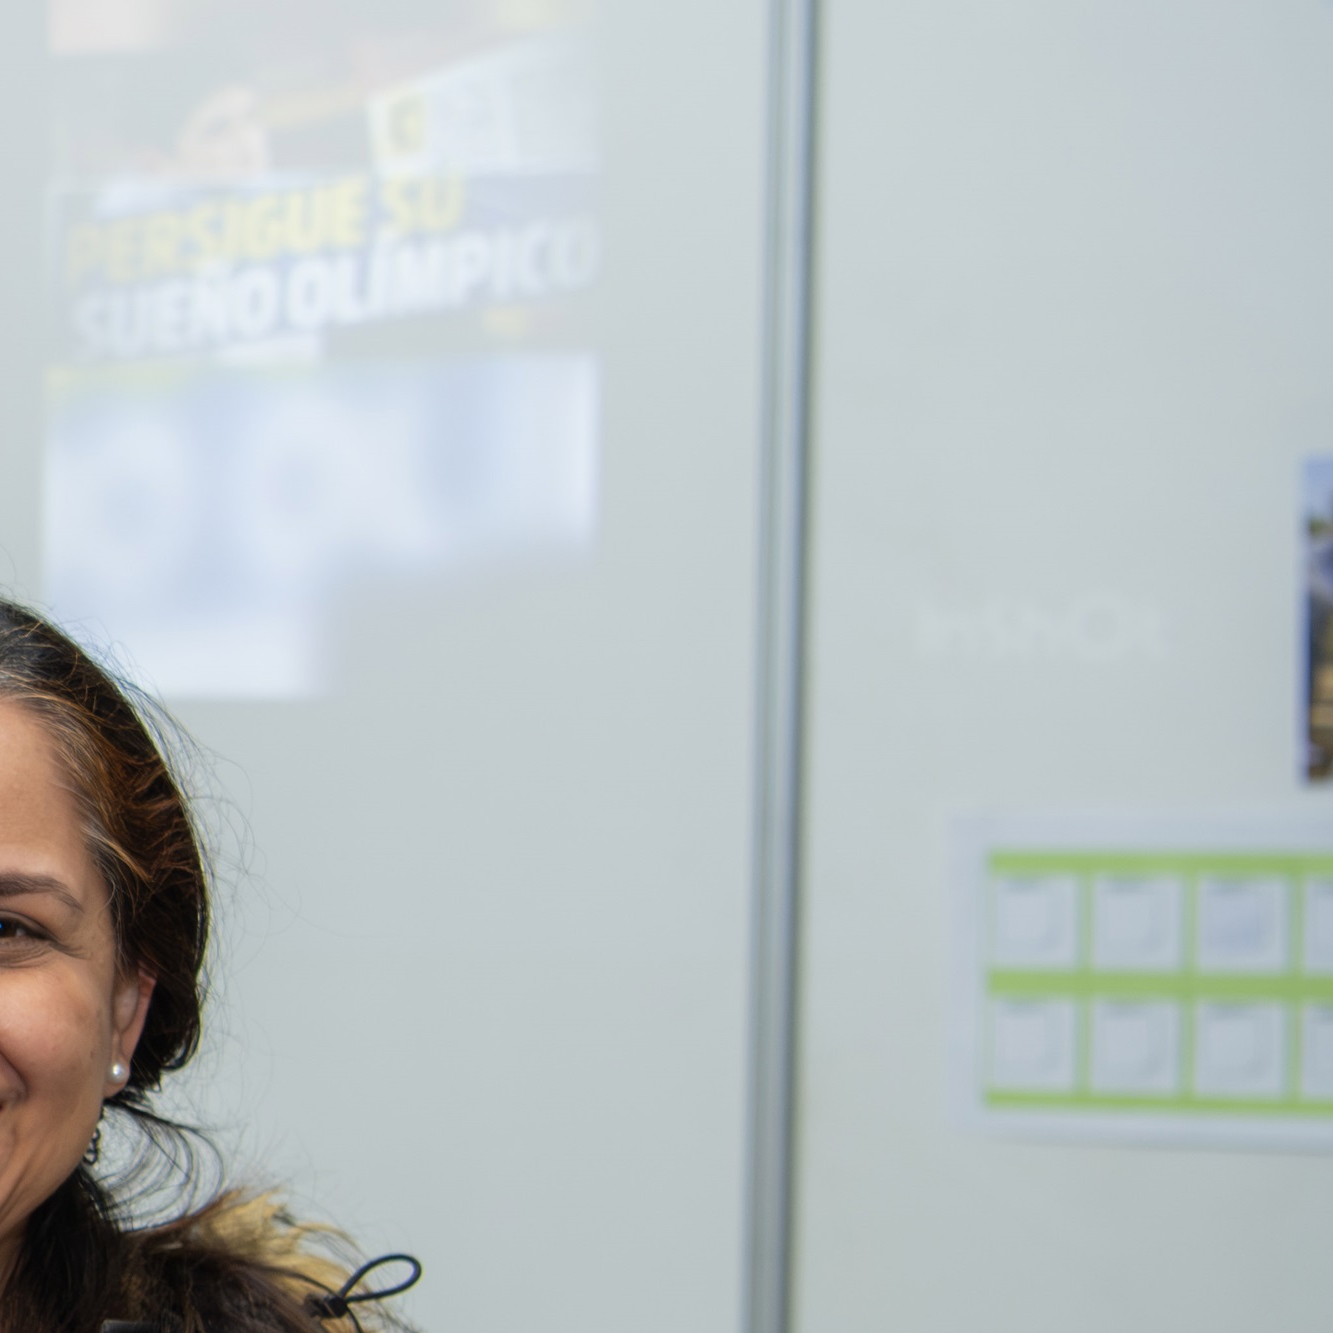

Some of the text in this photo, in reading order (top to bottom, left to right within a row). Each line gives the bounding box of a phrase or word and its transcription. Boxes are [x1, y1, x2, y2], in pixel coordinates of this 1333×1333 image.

[65, 171, 467, 286] PERSIGUE SU
[71, 213, 602, 362] SUEÑO OLÍMPICO
